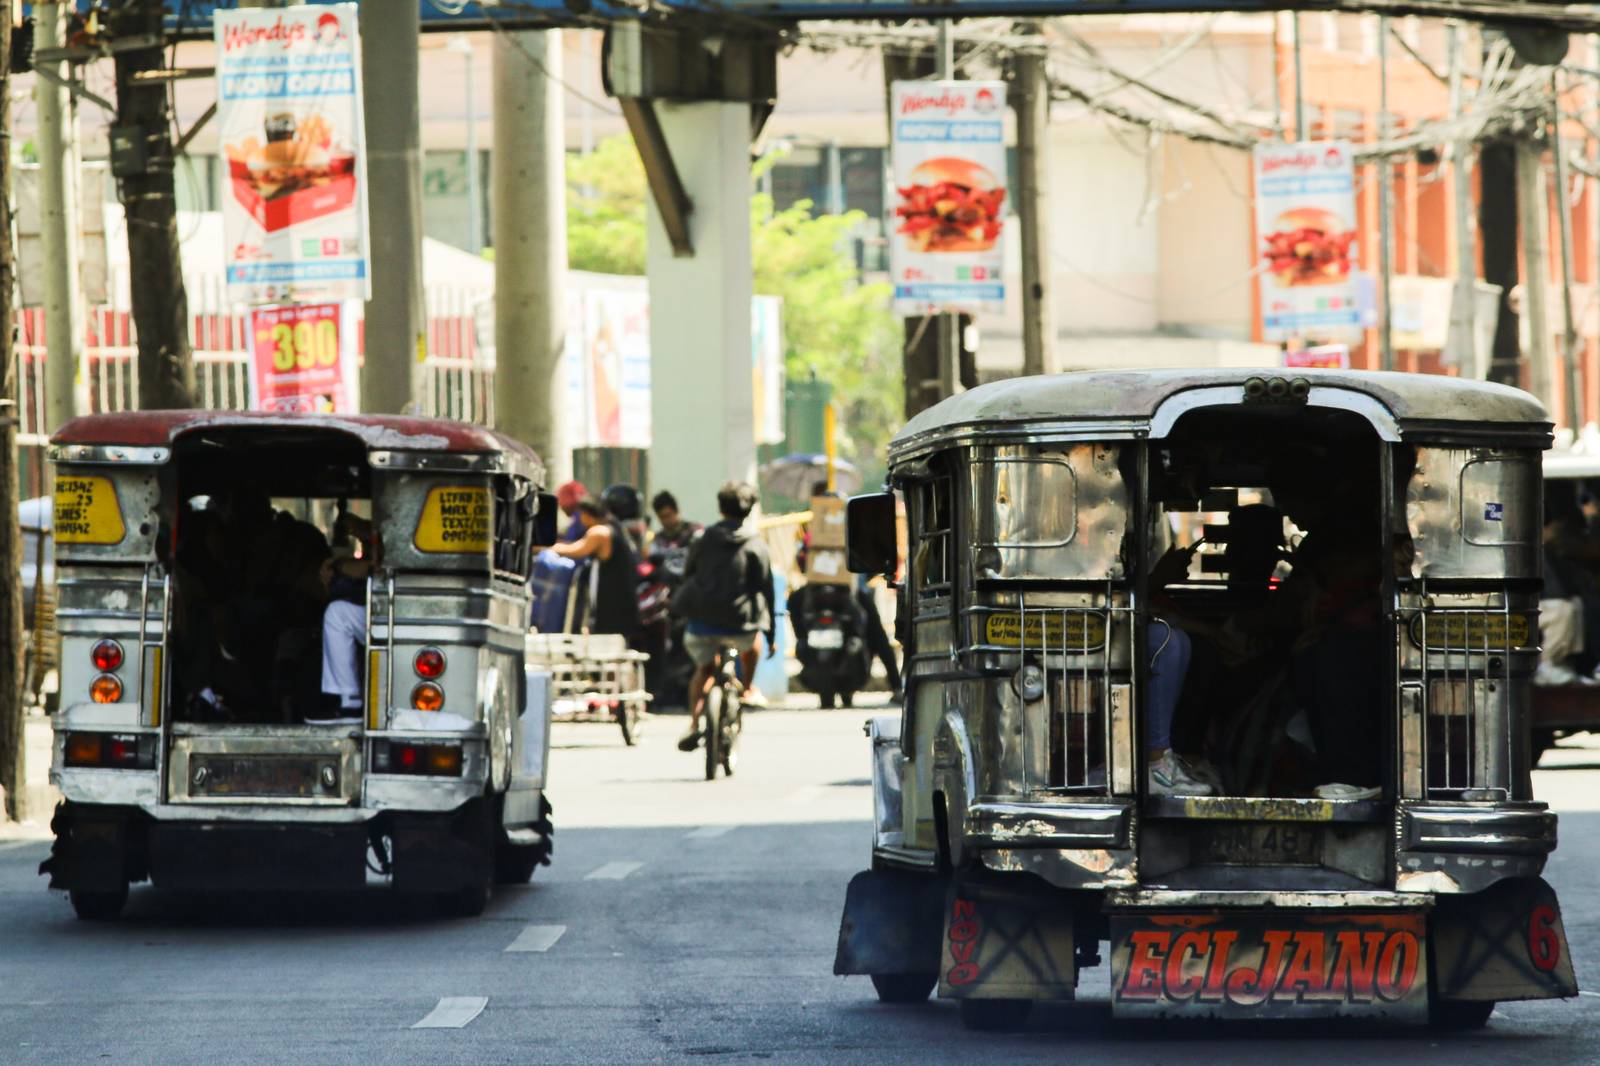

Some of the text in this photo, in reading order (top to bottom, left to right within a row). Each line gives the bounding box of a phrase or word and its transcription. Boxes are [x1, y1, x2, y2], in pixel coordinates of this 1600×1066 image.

[222, 15, 305, 51] Wendy's
[225, 70, 351, 97] NOW OPEN
[949, 898, 979, 986] NOVO
[1118, 930, 1420, 1005] ECIJANO
[1528, 904, 1560, 973] 6
